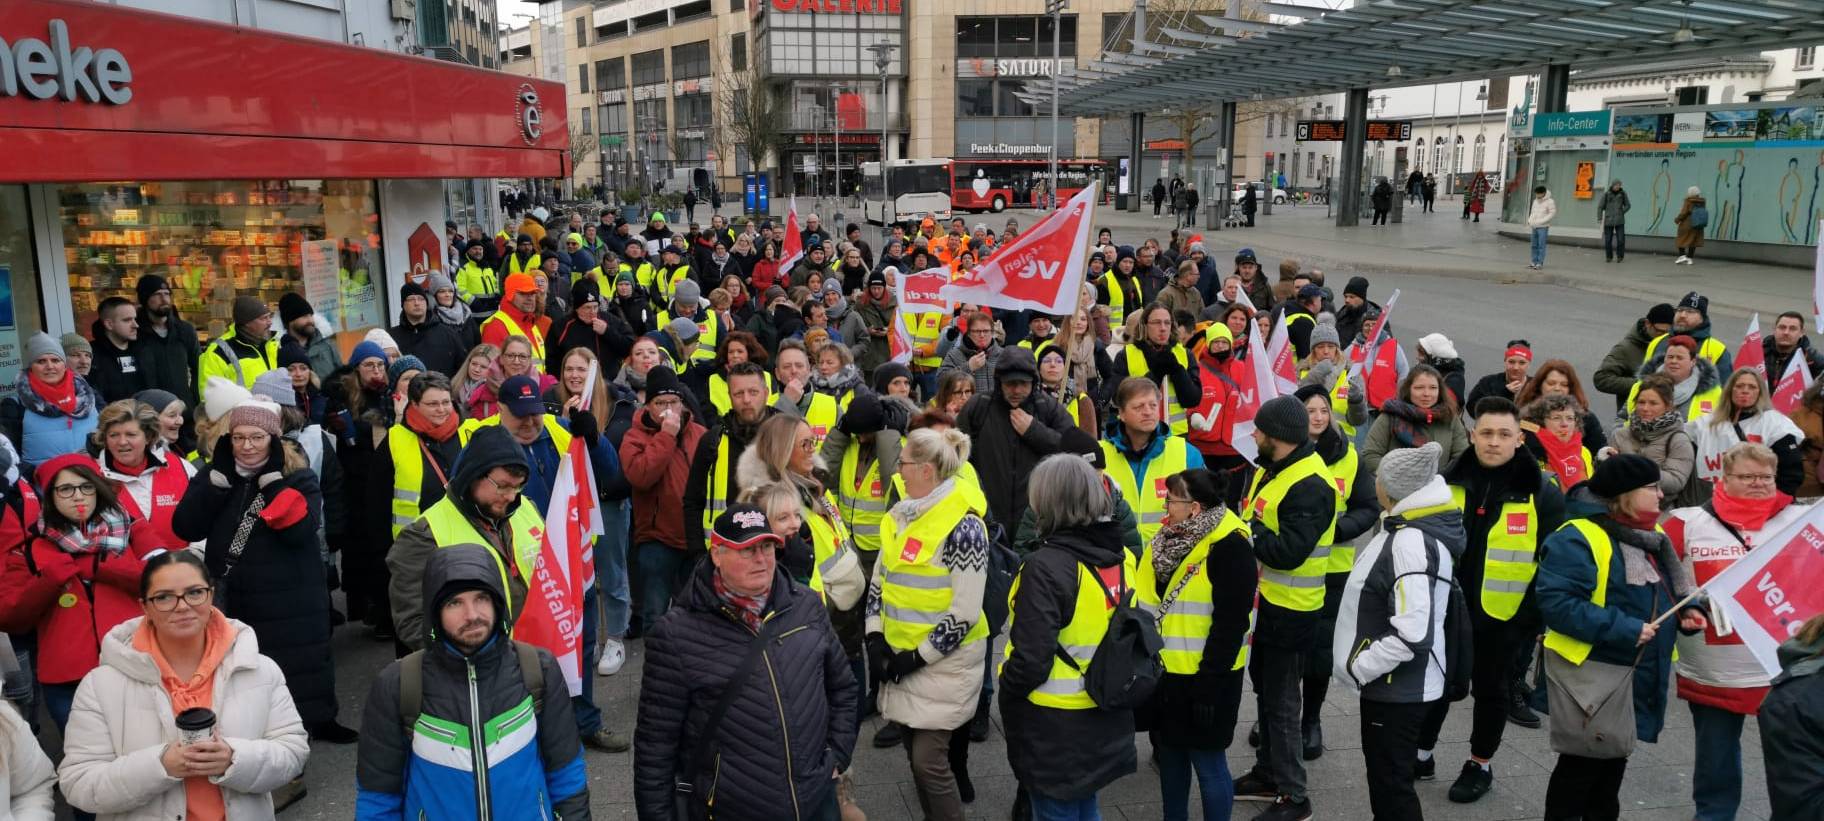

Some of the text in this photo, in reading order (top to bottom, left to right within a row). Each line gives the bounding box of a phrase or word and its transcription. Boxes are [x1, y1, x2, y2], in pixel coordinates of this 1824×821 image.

[1547, 117, 1600, 131] Info-Center
[1690, 545, 1757, 558] POWER
[535, 553, 576, 649] estfalen
